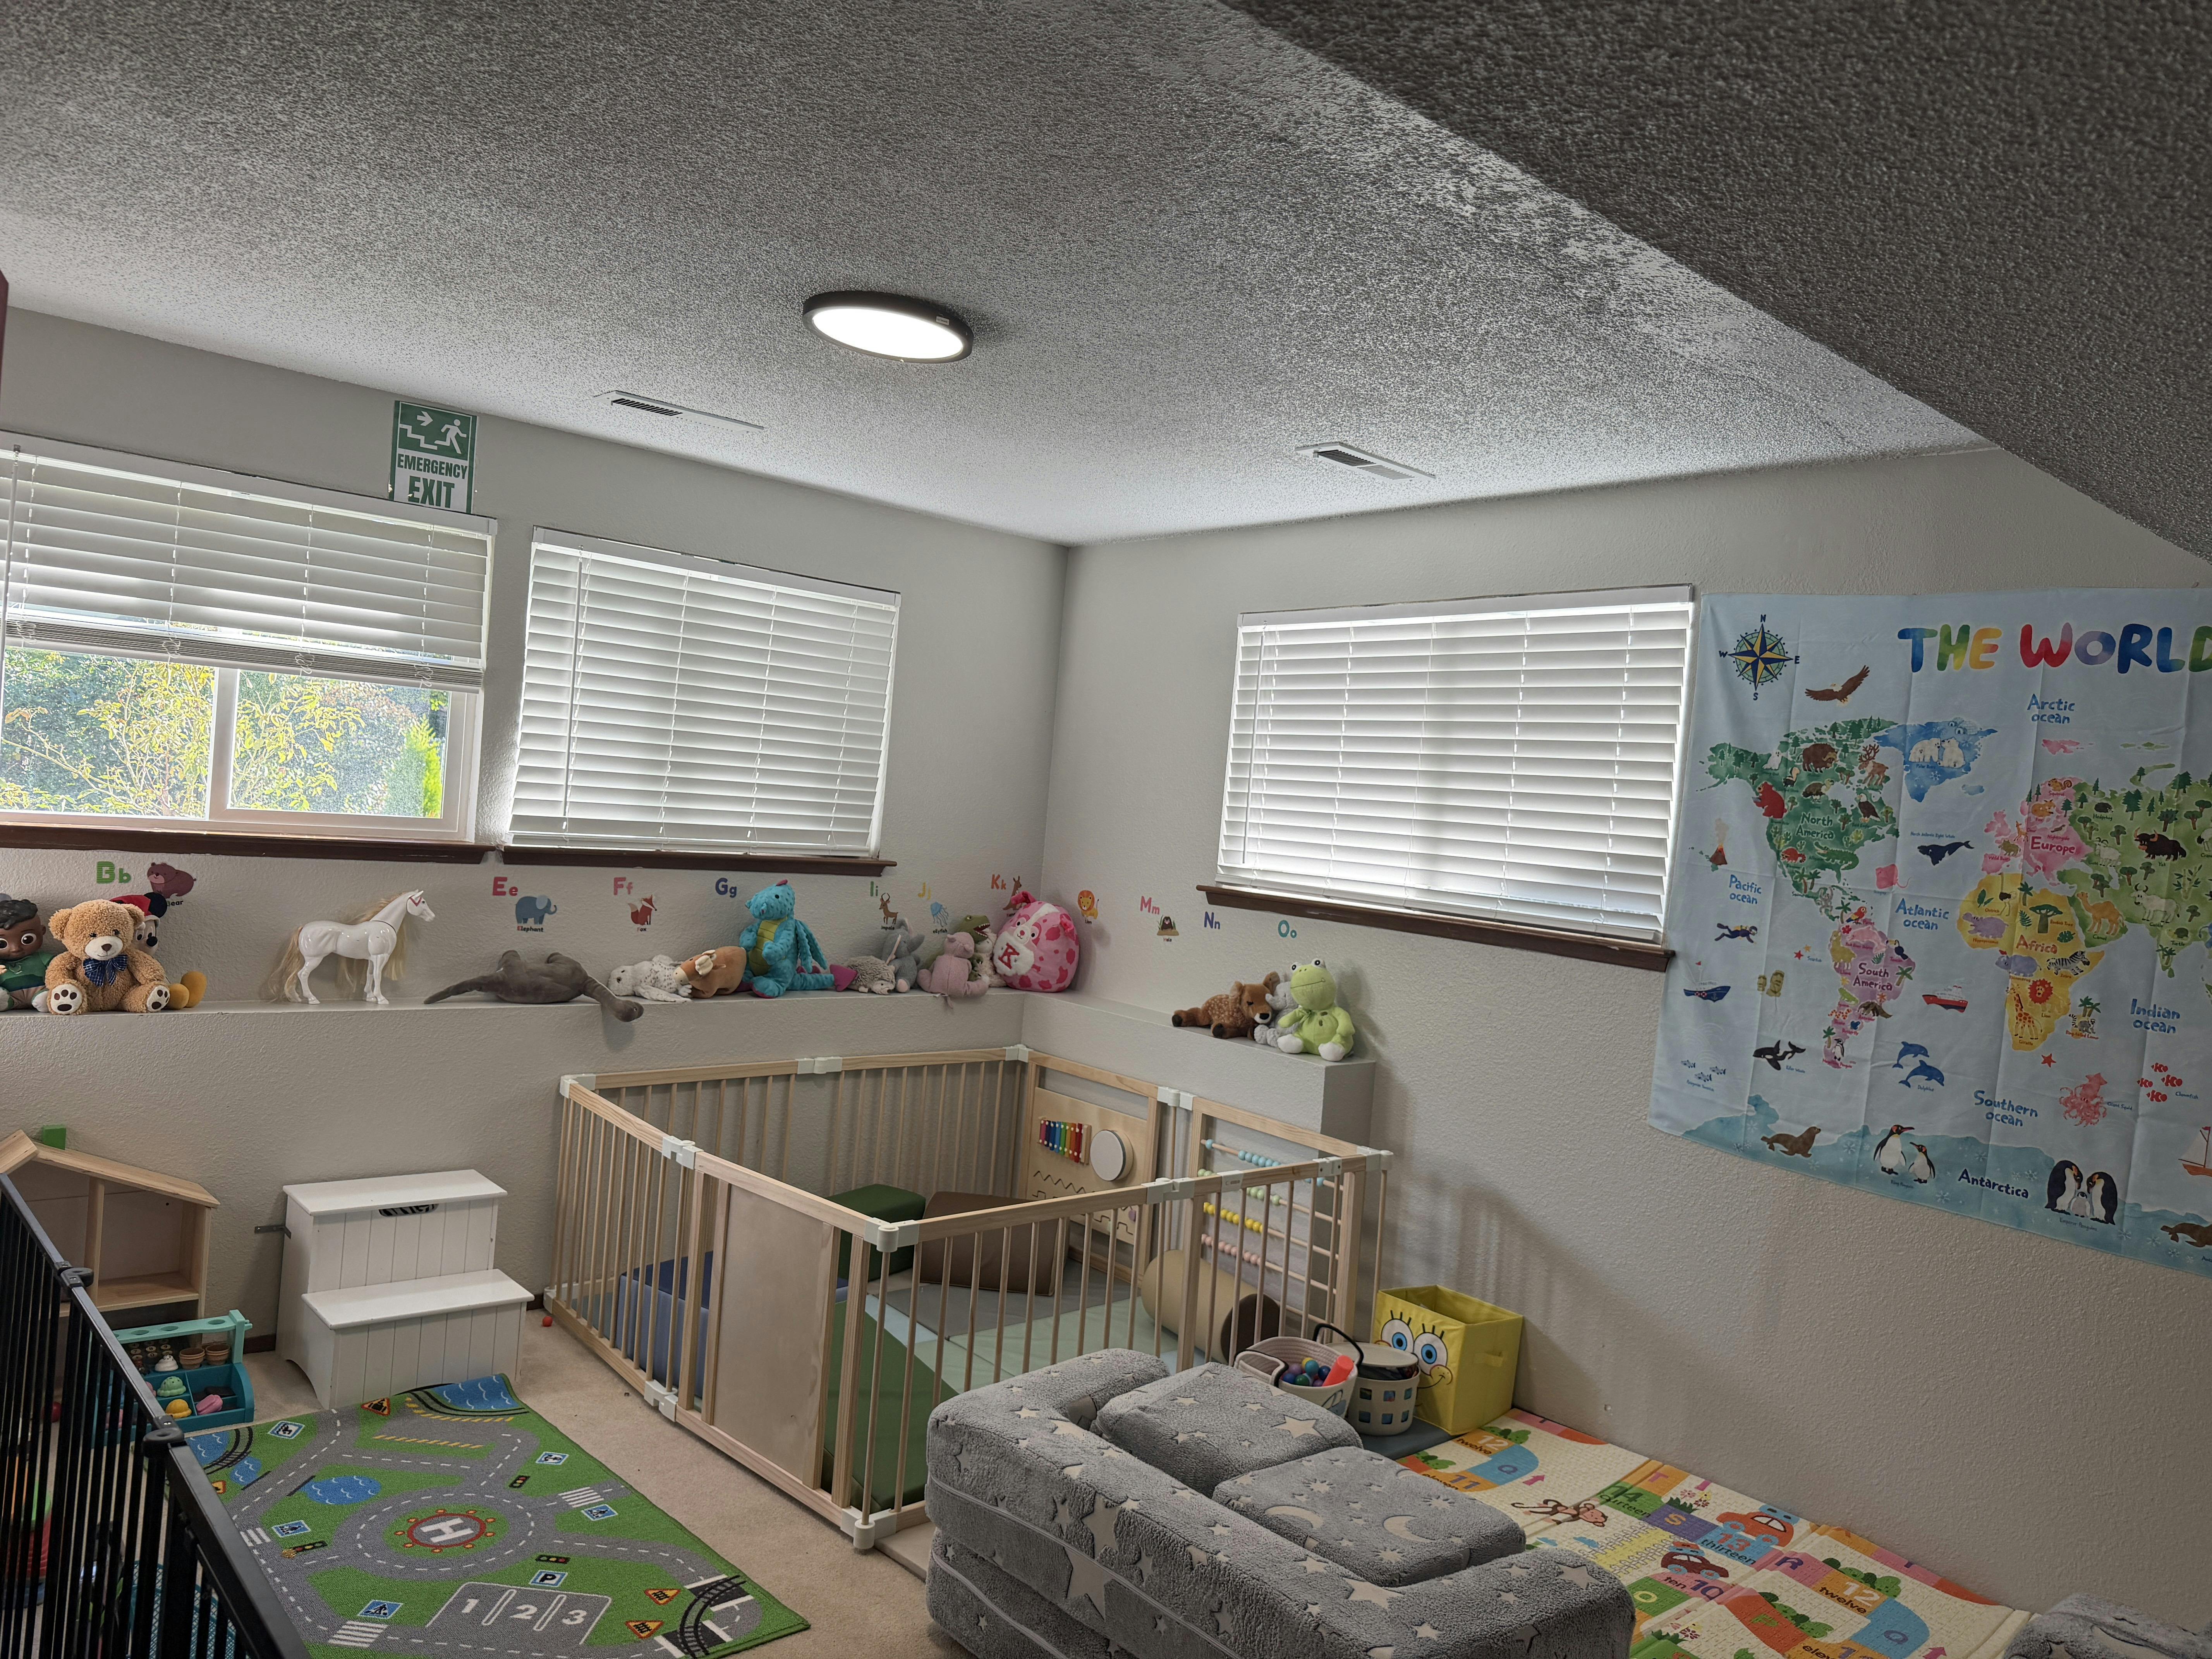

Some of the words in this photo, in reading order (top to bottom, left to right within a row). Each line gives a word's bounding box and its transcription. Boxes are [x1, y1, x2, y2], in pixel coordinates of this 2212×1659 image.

[397, 453, 468, 479] EMERGENCY
[408, 475, 455, 508] EXIT
[1760, 614, 1766, 622] N
[1897, 623, 2002, 673] THE
[2020, 622, 2212, 674] WORLD
[1795, 656, 1800, 664] E
[1753, 692, 1759, 701] S
[2027, 693, 2075, 712] Arctic
[2031, 713, 2070, 724] ocean
[1801, 812, 1833, 826] North
[1796, 825, 1834, 840] America
[2030, 836, 2075, 855] Europe
[96, 861, 131, 884] Bb
[492, 876, 519, 896] Ee
[613, 877, 634, 895] Ff
[715, 878, 737, 898] Gg
[991, 874, 1006, 890] Kk
[1729, 874, 1762, 894] Pacific
[1139, 895, 1160, 914] Mm
[1729, 892, 1757, 905] ocean
[1895, 898, 1949, 919] Atlantic
[1204, 912, 1221, 930] Nn
[1278, 920, 1297, 939] Oo
[1903, 919, 1938, 930] ocean
[2016, 934, 2058, 954] Africa
[1858, 962, 1889, 977] South
[1853, 975, 1893, 991] America
[2130, 998, 2181, 1020] Indian
[2133, 1020, 2176, 1034] ocean
[1974, 1090, 2038, 1118] Southern
[1985, 1111, 2023, 1127] ocean
[1958, 1168, 2029, 1199] Antarctica
[1456, 1437, 1492, 1455] twelve
[1477, 1435, 1509, 1451] 12
[1498, 1465, 1518, 1475] Q
[1450, 1475, 1482, 1490] 11
[1609, 1486, 1644, 1503] 14
[1664, 1513, 1686, 1526] S
[420, 1517, 474, 1543] H
[1717, 1533, 1751, 1551] 13
[1701, 1539, 1757, 1565] thirteen
[1776, 1556, 1804, 1571] R
[539, 1573, 557, 1585] P
[1663, 1576, 1686, 1589] ten
[1690, 1579, 1724, 1601] 10
[1842, 1582, 1881, 1607] 12
[1819, 1586, 1867, 1614] twelve
[462, 1599, 479, 1613] 1
[511, 1604, 538, 1620] 2
[562, 1609, 588, 1625] 3
[1883, 1630, 1909, 1645] Q
[1838, 1646, 1874, 1659] 1
